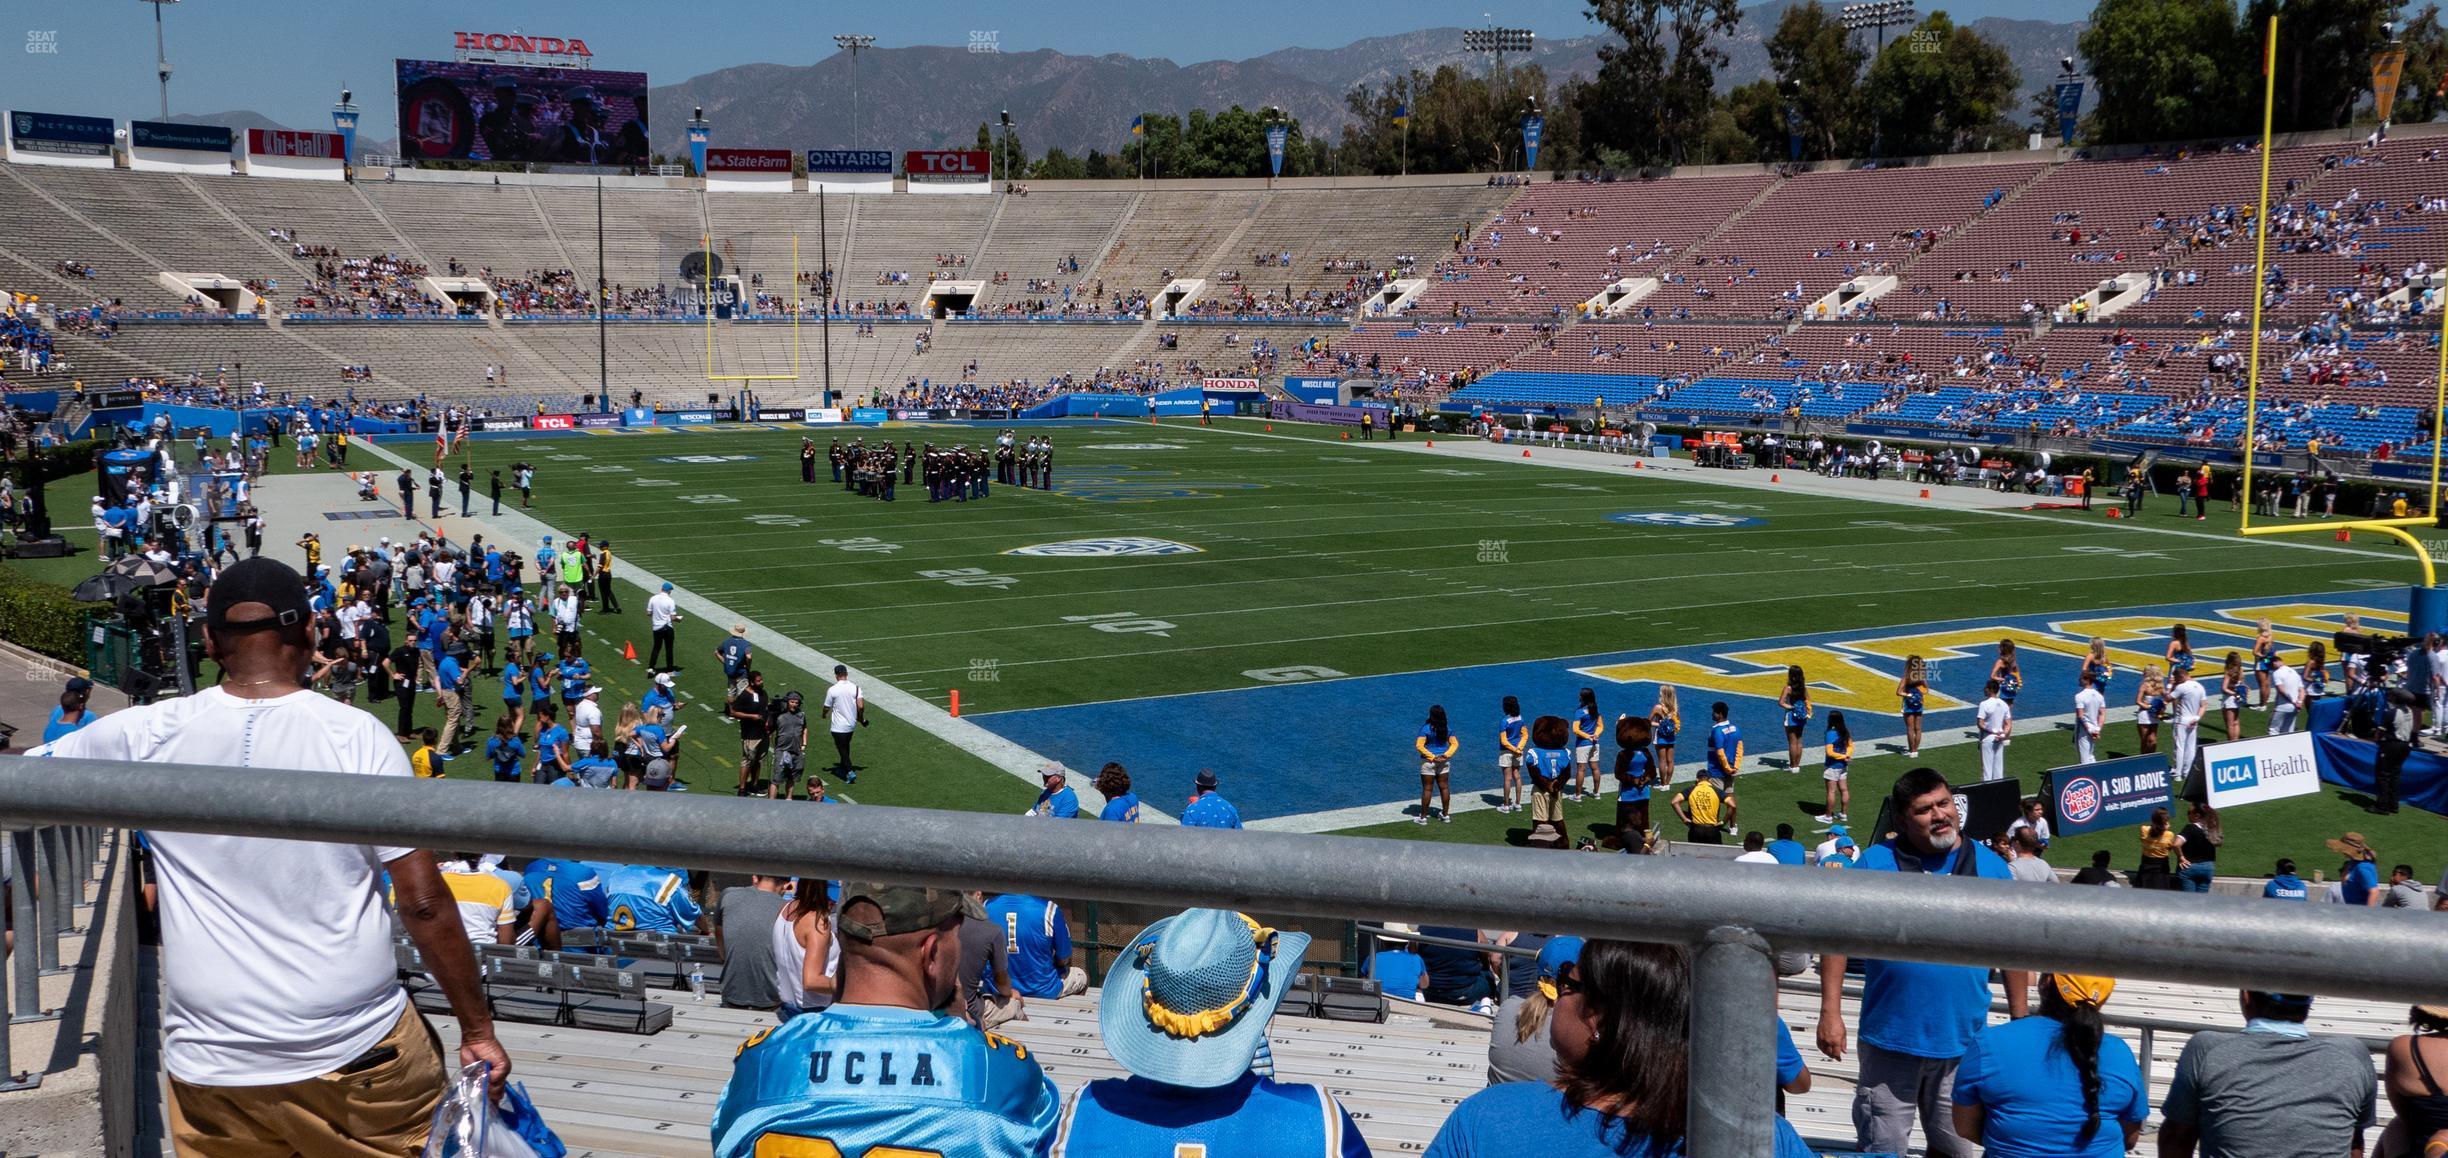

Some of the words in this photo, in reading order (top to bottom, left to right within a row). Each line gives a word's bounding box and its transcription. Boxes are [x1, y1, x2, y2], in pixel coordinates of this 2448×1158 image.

[454, 32, 593, 56] HONDA
[38, 122, 113, 134] NETWORKS
[151, 134, 201, 143] Northwestern
[203, 137, 229, 145] Mutual
[809, 152, 891, 166] ONTARIO
[922, 154, 975, 171] TCL
[671, 289, 734, 305] Allstate
[1204, 380, 1257, 388] HONDA
[484, 421, 523, 429] NISSAN
[538, 418, 569, 428] TCL
[2066, 480, 2073, 489] G
[912, 567, 1020, 587] 20
[1059, 611, 1178, 633] 10
[1567, 603, 2410, 717] UCLA
[1240, 665, 1350, 682] G
[2217, 763, 2252, 785] UCLA
[2261, 754, 2310, 779] Health
[2102, 779, 2109, 797] A
[2112, 776, 2131, 795] SUB
[2120, 795, 2168, 811] jerseymikes.com
[1006, 912, 1019, 953] 1
[1072, 1047, 1090, 1055] 10
[809, 1051, 935, 1086] UCLA
[572, 1081, 588, 1089] 2
[680, 1092, 696, 1100] 3
[1399, 1142, 1424, 1151] 10
